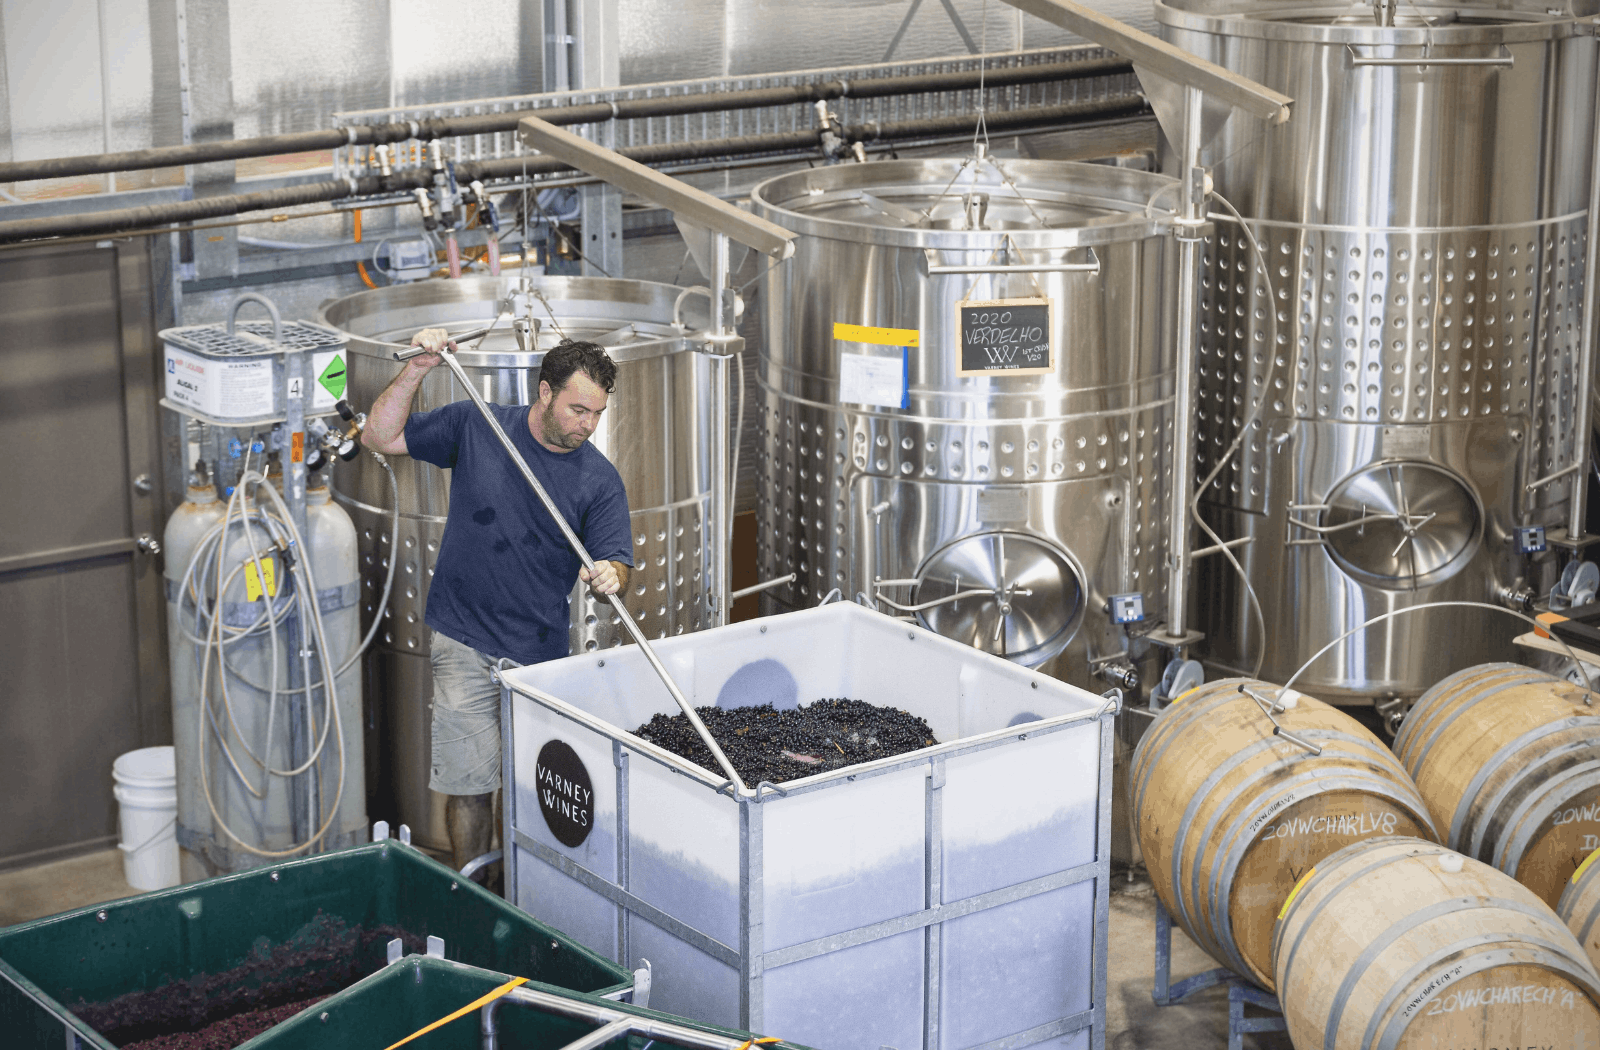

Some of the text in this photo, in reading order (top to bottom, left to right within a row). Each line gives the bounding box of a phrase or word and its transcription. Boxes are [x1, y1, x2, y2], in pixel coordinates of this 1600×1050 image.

[971, 311, 1012, 325] 2020
[965, 325, 1042, 345] VERDELHO
[290, 379, 299, 394] 4
[537, 763, 591, 806] VARNEY
[542, 788, 588, 827] WINES
[1262, 811, 1398, 842] 20VWCHARLV8
